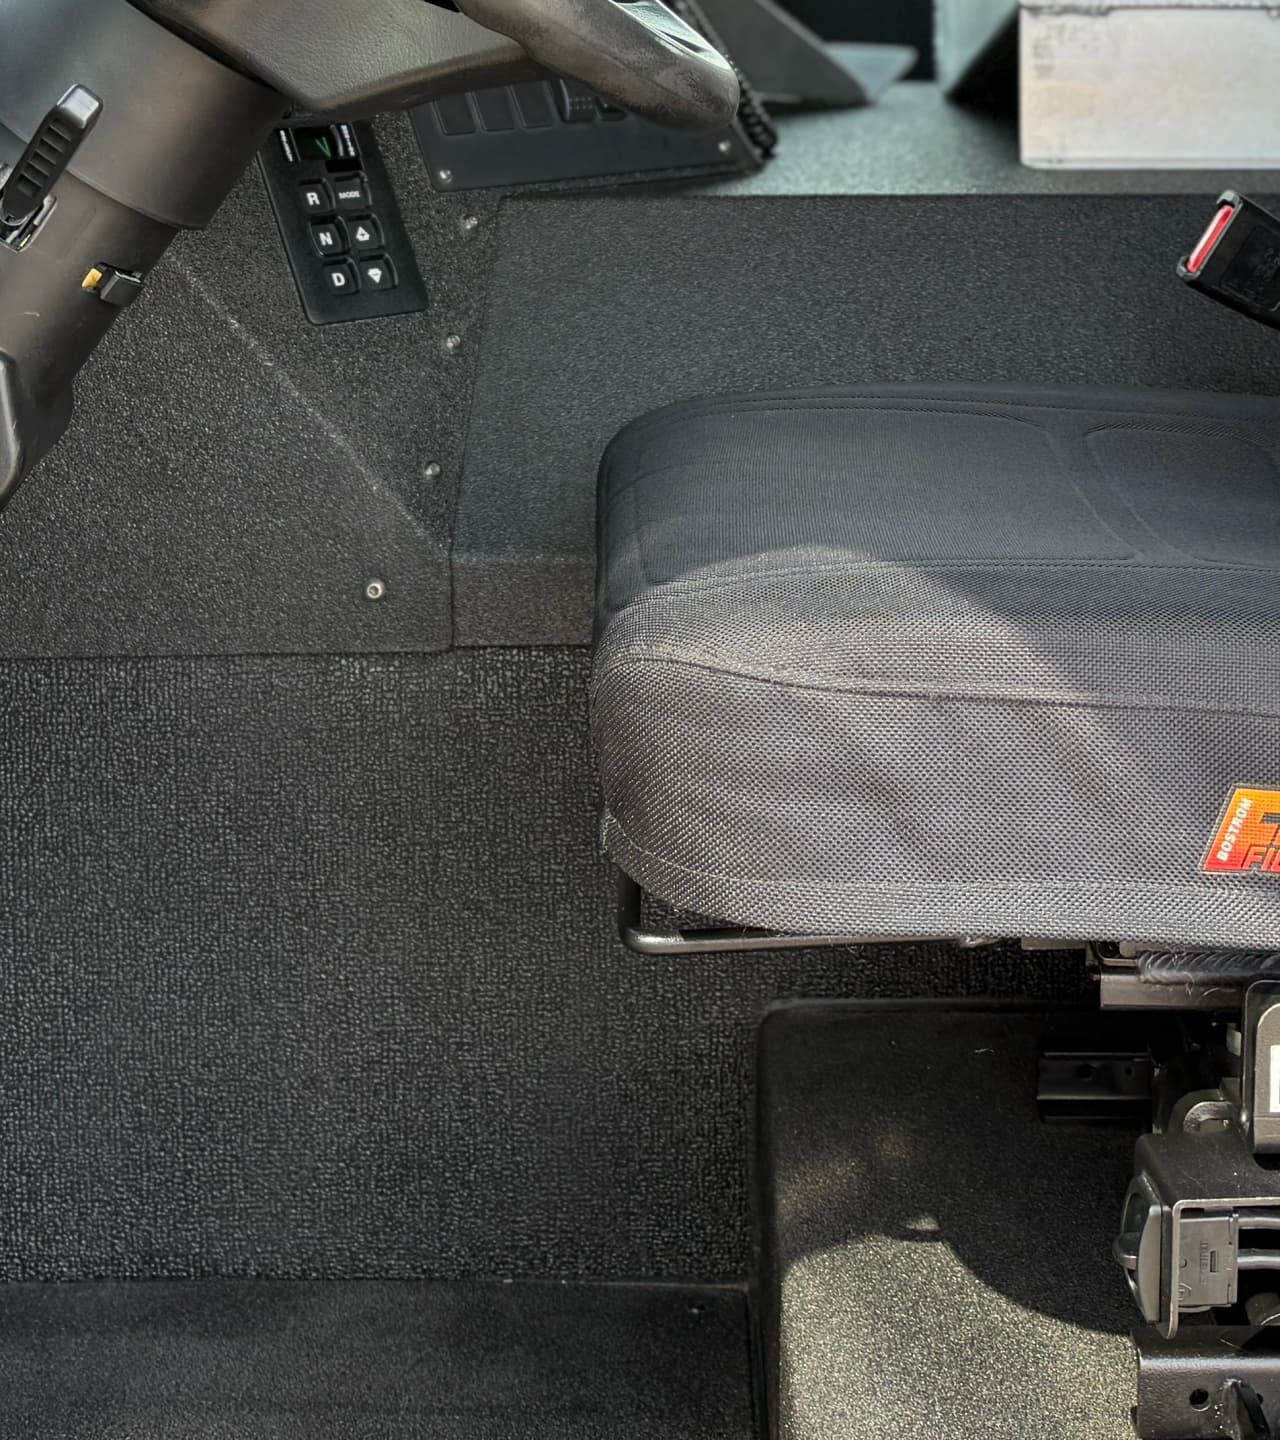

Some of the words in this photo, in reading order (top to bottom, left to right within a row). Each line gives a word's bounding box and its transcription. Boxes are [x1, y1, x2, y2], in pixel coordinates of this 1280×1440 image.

[306, 192, 320, 206] R
[338, 190, 360, 199] MODE
[319, 232, 333, 246] N
[331, 272, 346, 287] D
